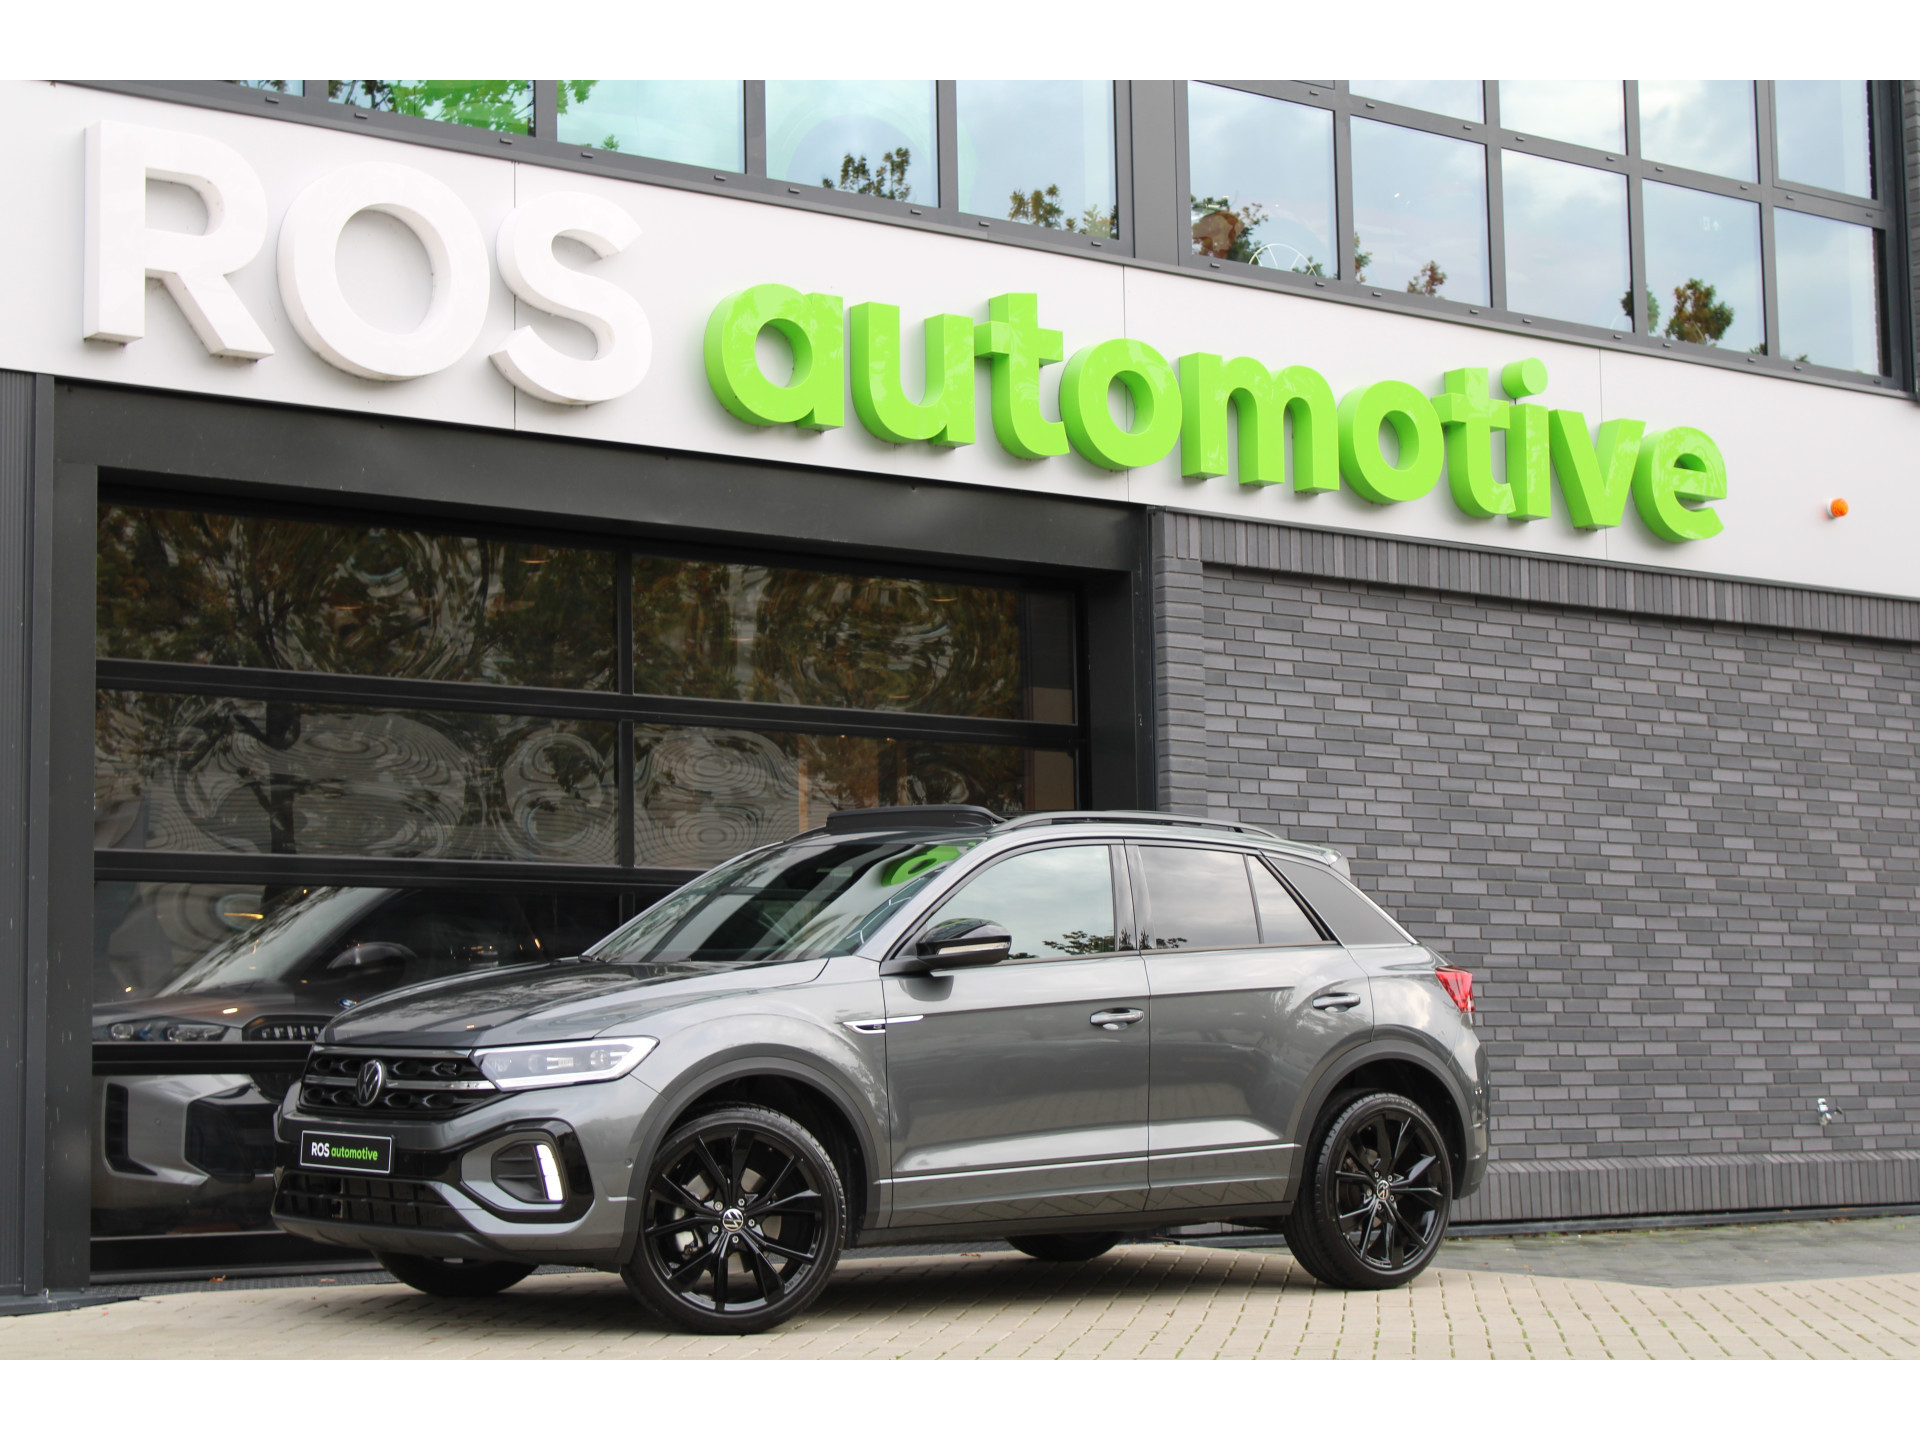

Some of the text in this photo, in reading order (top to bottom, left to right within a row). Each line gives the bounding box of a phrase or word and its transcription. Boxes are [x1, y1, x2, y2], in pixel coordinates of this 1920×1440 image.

[84, 119, 1727, 543] ROS automotive
[311, 1142, 378, 1161] ROS automotive
